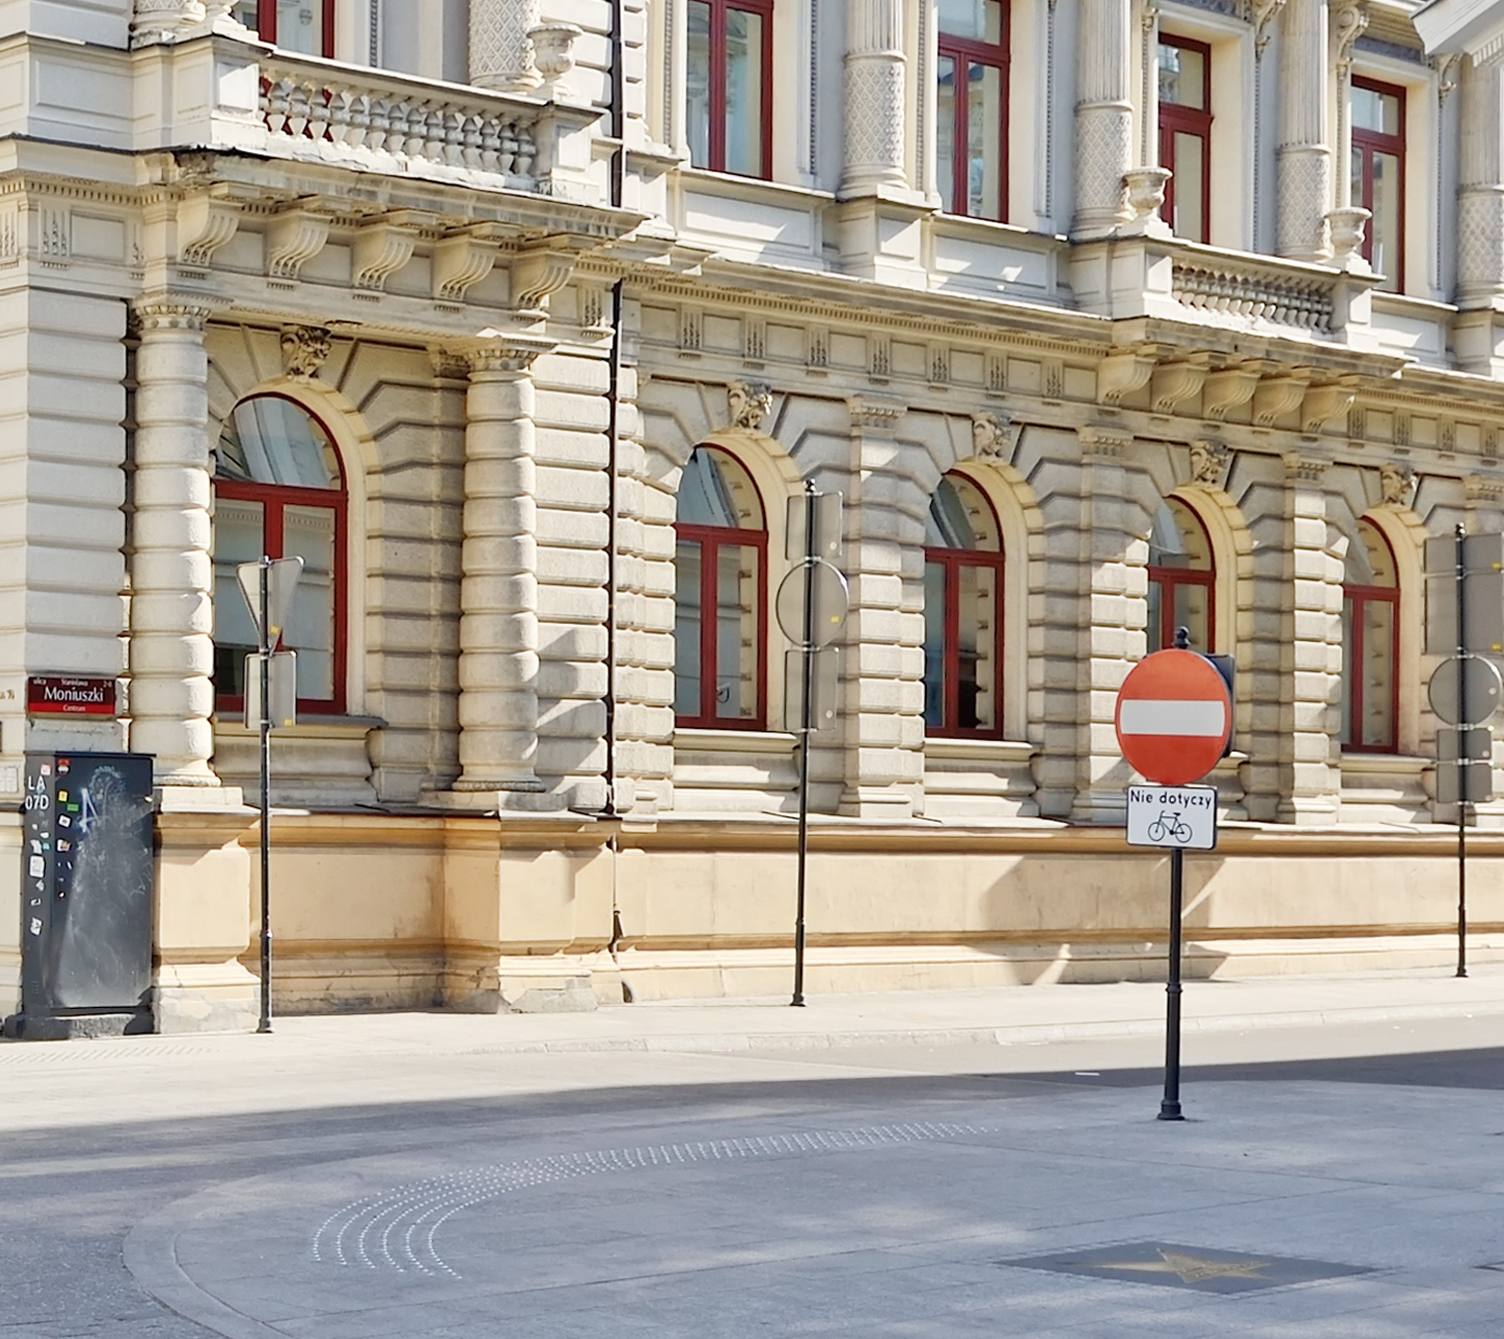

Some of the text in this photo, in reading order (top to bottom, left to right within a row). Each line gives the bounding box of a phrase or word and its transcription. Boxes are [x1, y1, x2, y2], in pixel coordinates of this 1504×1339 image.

[44, 687, 104, 702] Moniuszki
[28, 775, 46, 790] LA
[25, 795, 49, 810] 07D
[1130, 790, 1212, 809] Nie dotyczy
